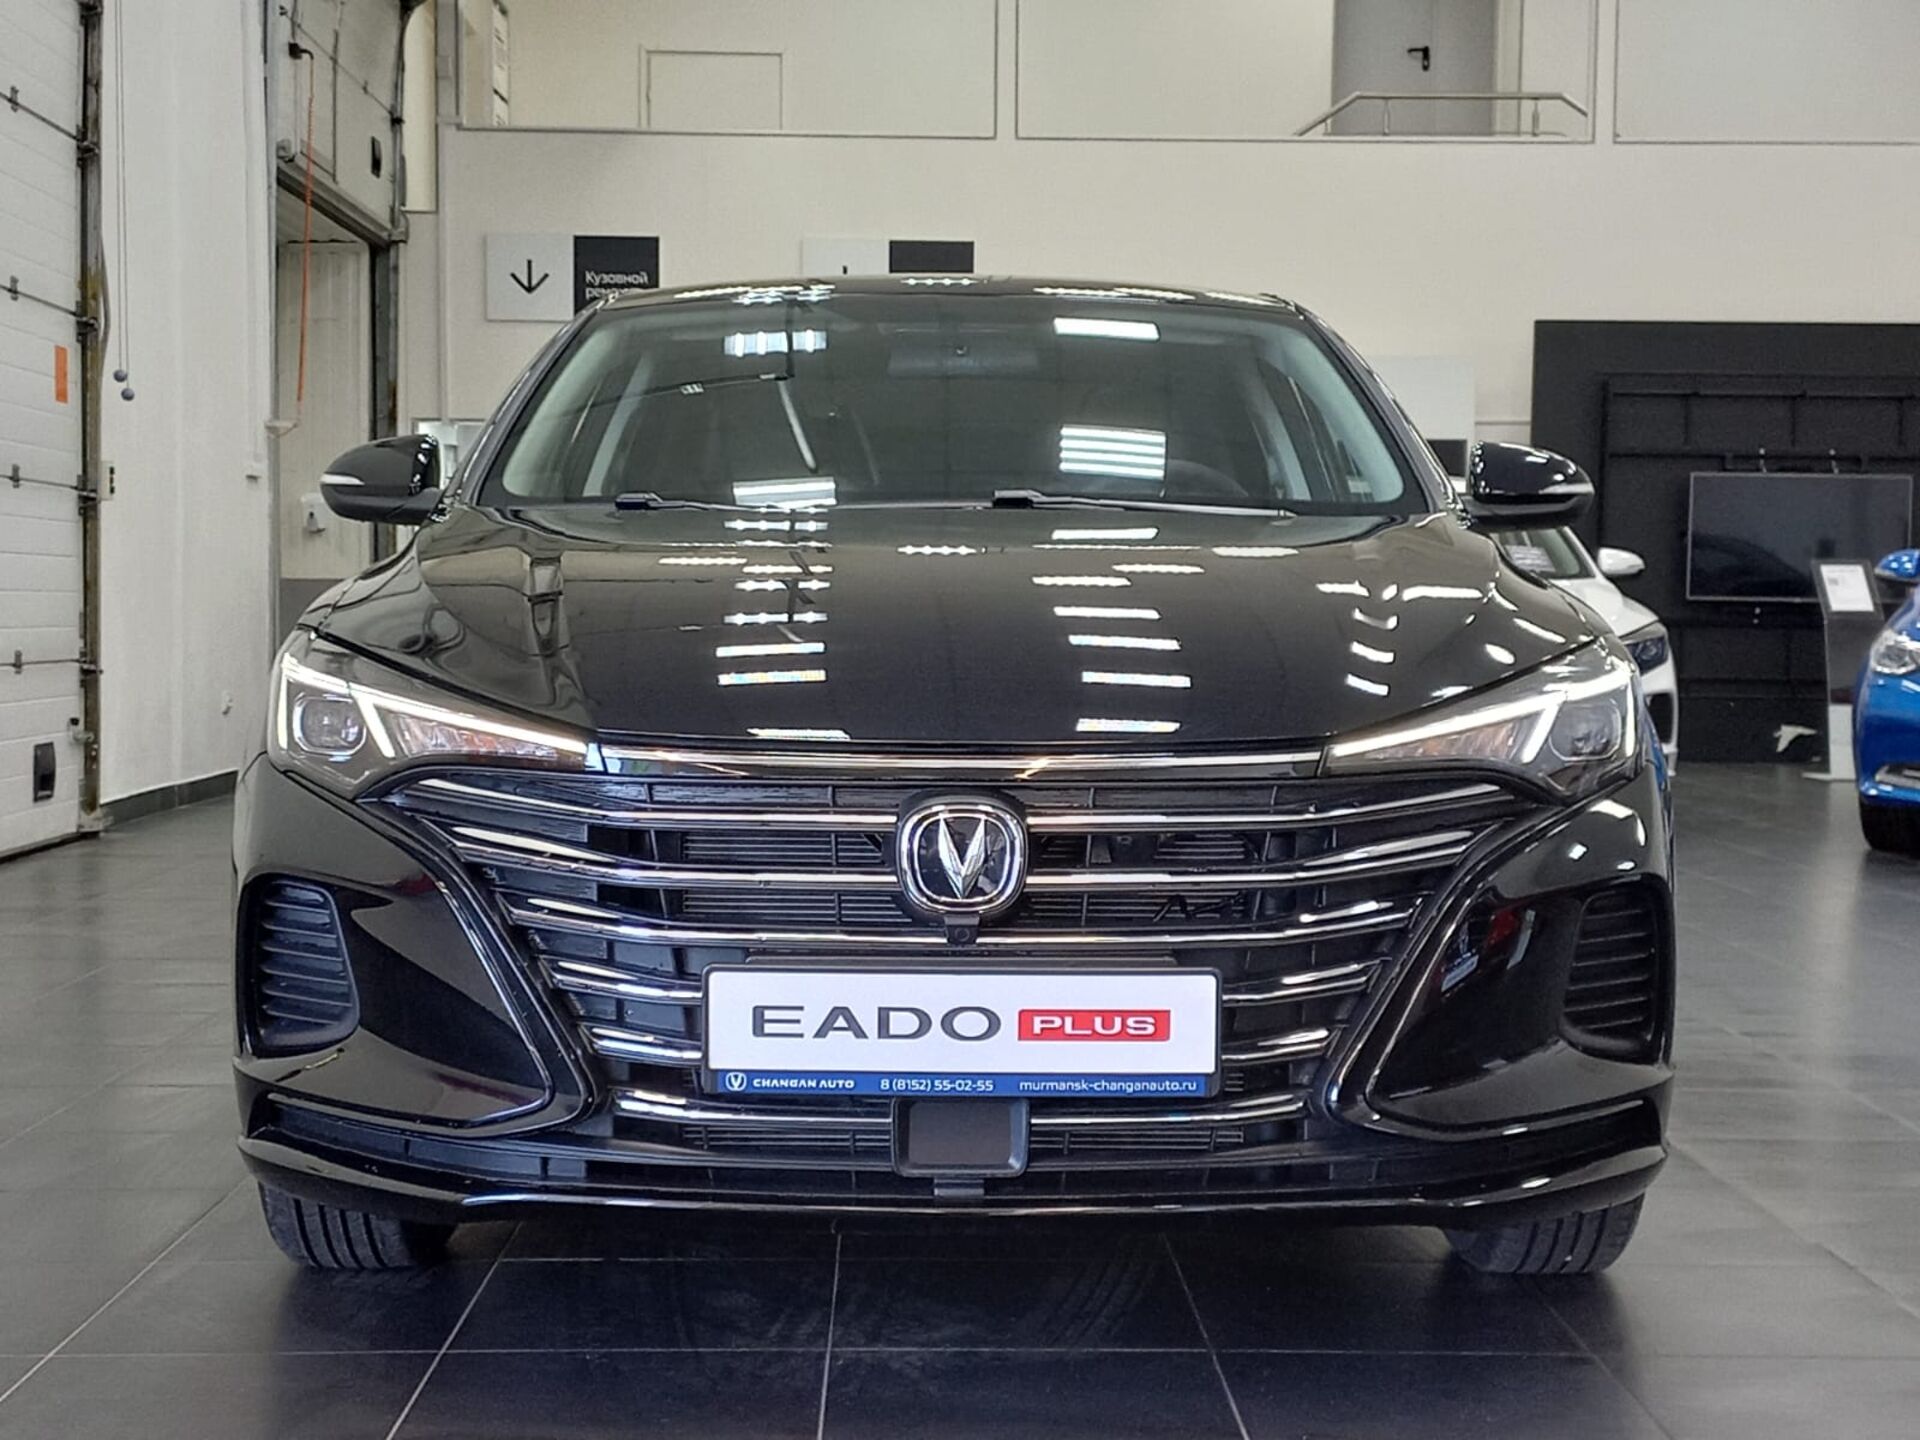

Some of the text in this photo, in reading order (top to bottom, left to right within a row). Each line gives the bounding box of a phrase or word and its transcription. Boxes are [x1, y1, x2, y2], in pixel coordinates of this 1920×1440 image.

[585, 270, 649, 285] Кузовной
[752, 1005, 1157, 1042] EADO PLUS
[753, 1077, 856, 1090] CHANGAN AUTO
[880, 1078, 994, 1092] 8 (8152) 55-02-55
[1019, 1079, 1197, 1094] murmansk-changanauto.ru
